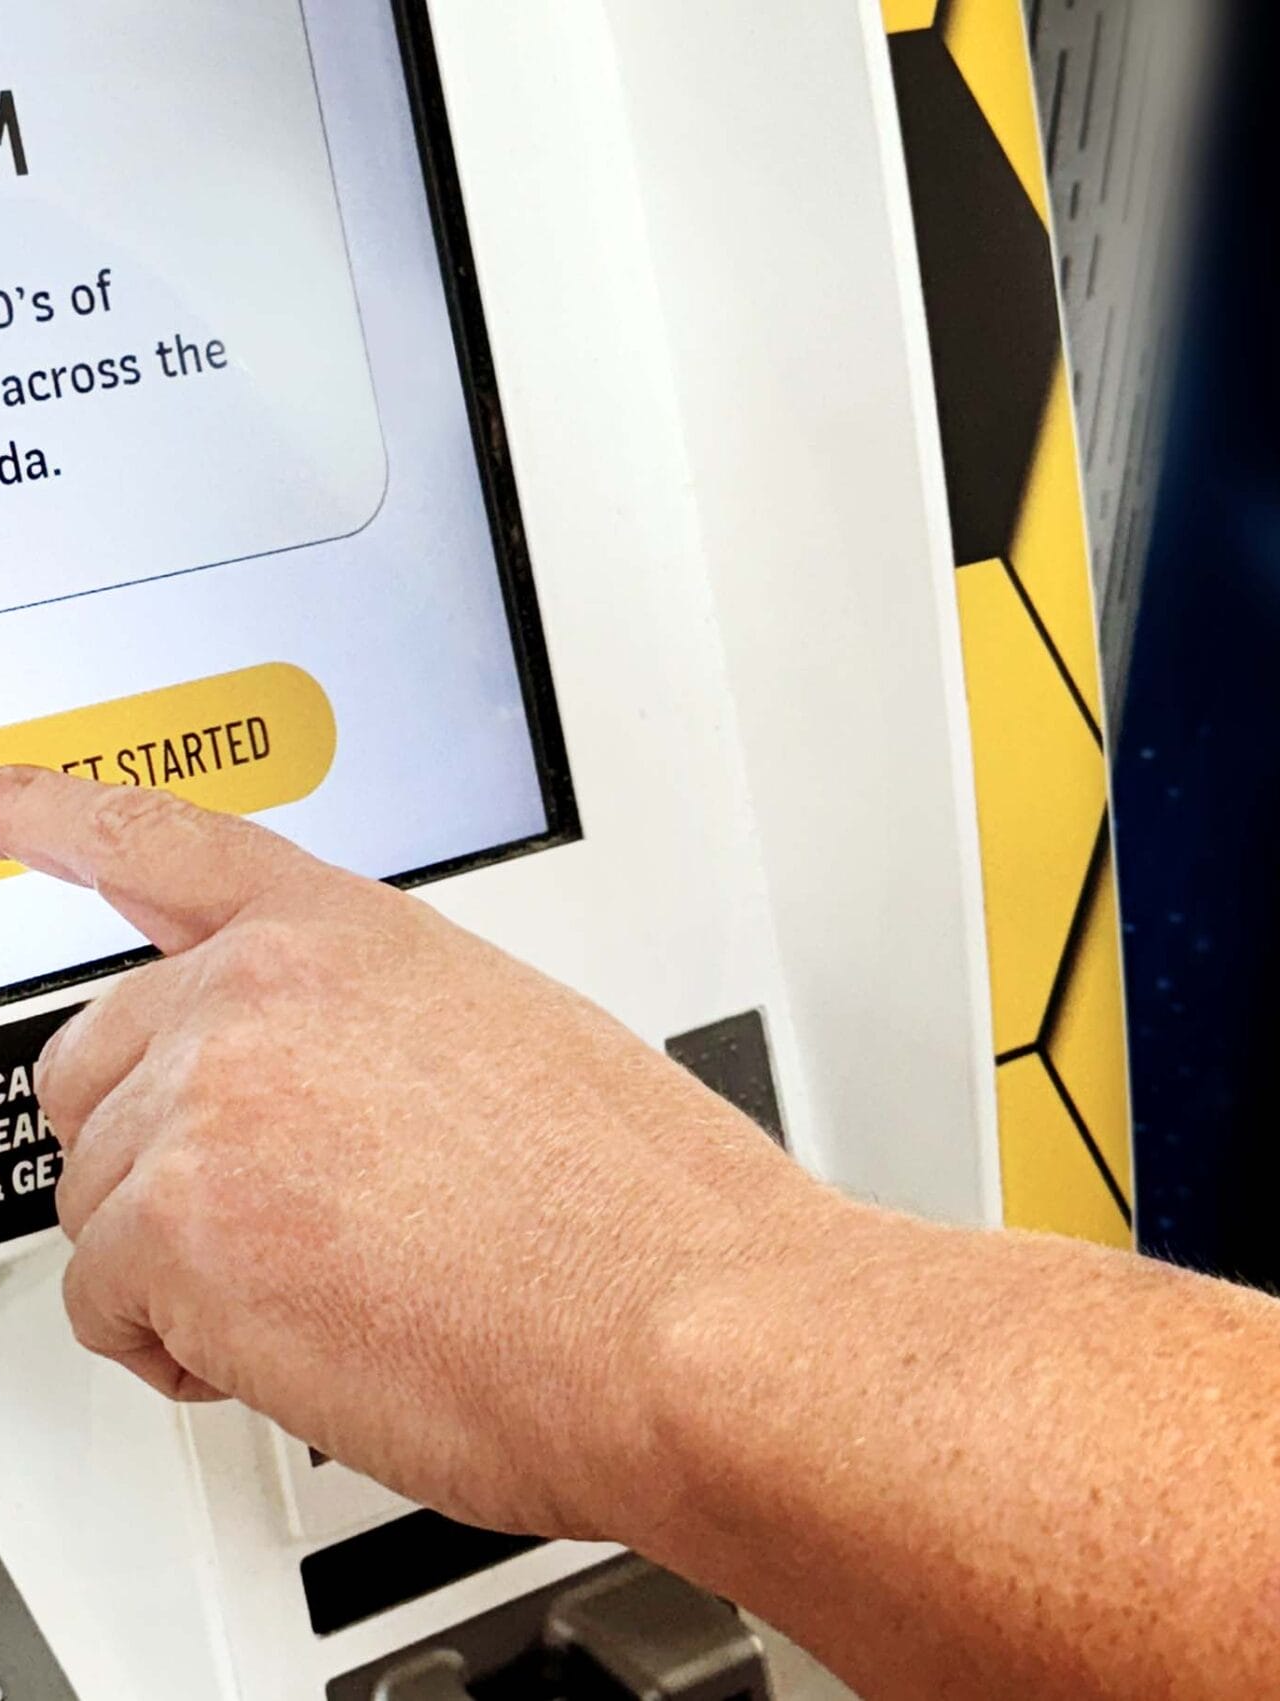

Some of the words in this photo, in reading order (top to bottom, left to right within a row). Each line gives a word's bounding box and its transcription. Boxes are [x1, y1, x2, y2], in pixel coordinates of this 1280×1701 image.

[71, 268, 114, 316] of
[1, 354, 141, 407] across
[155, 332, 228, 378] the
[116, 716, 271, 787] STARTED
[12, 1151, 64, 1195] GE
